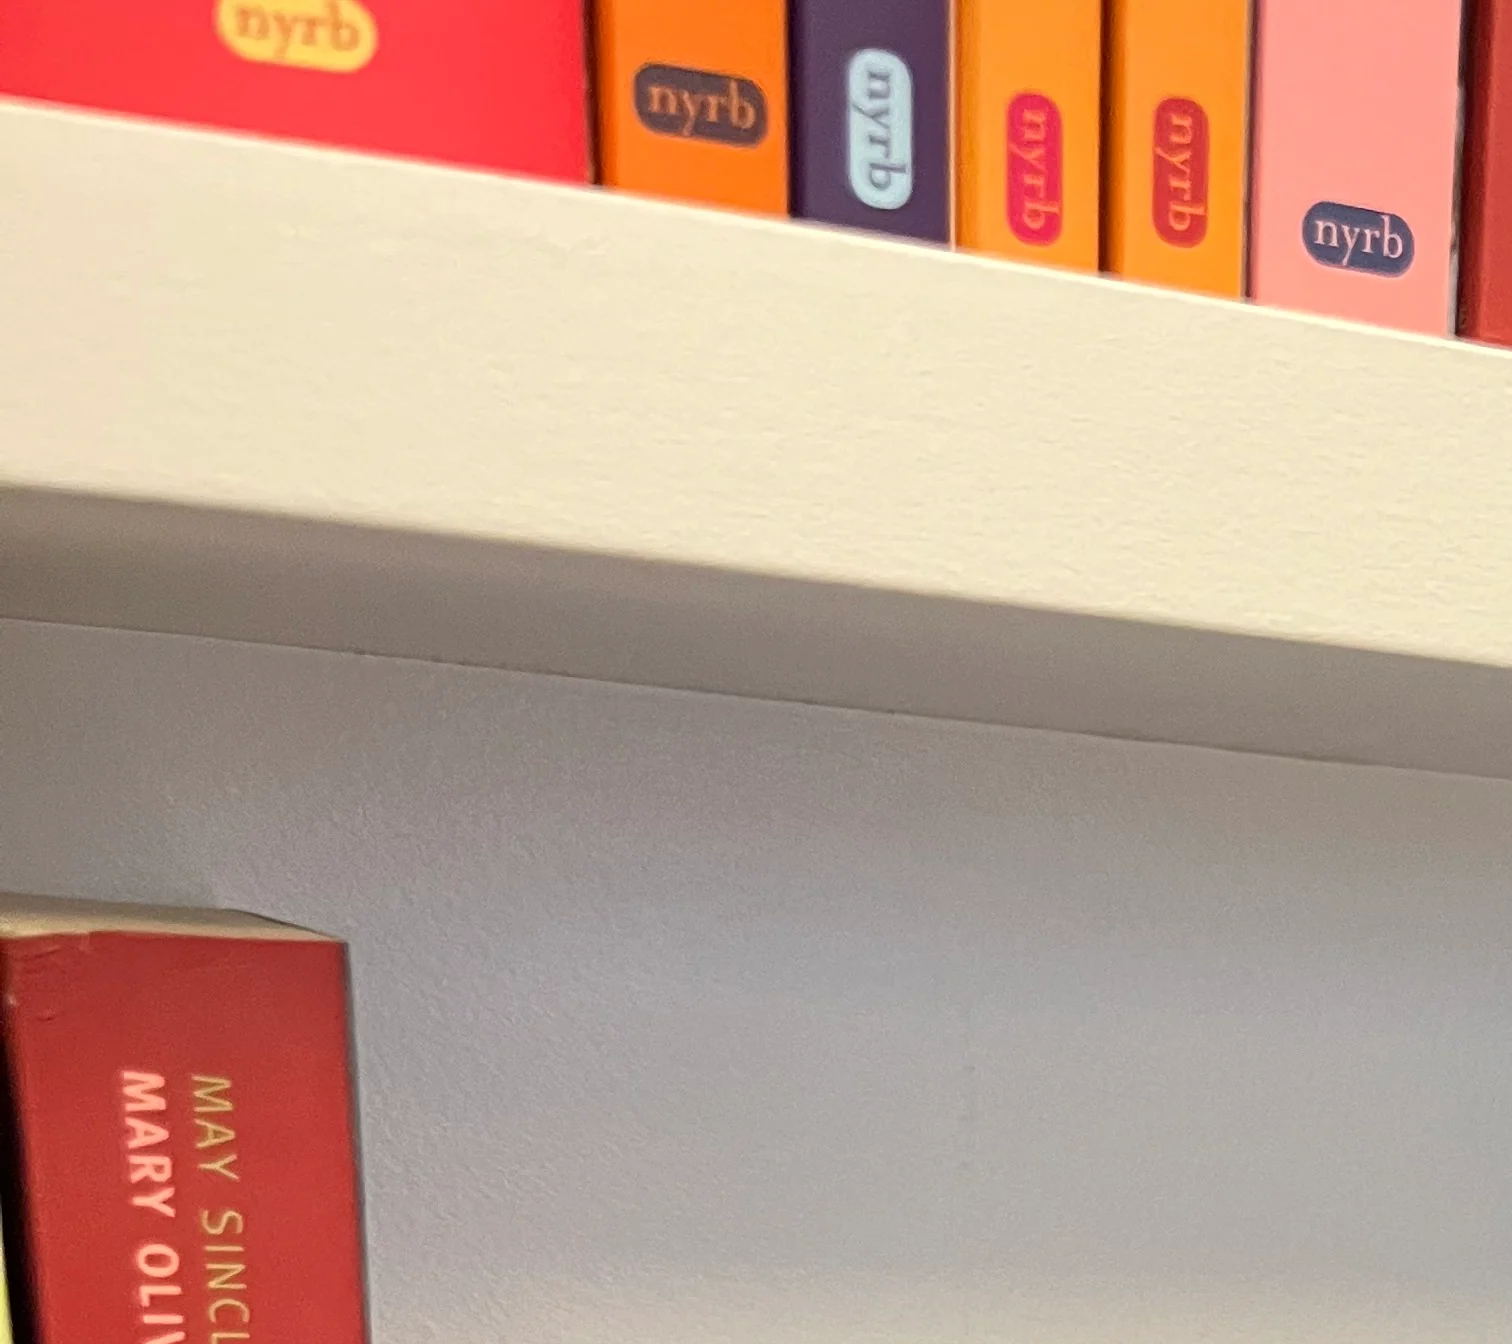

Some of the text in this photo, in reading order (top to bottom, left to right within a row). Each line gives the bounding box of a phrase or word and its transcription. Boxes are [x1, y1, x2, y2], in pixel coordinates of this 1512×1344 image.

[234, 0, 360, 60] nyrb
[648, 80, 755, 136] nyrb
[851, 68, 910, 188] nyrb
[1021, 106, 1060, 230] nyrb
[1165, 110, 1206, 232] nyrb
[1314, 215, 1402, 270] nyrb
[120, 1069, 174, 1216] MARY
[191, 1074, 239, 1180] MAY
